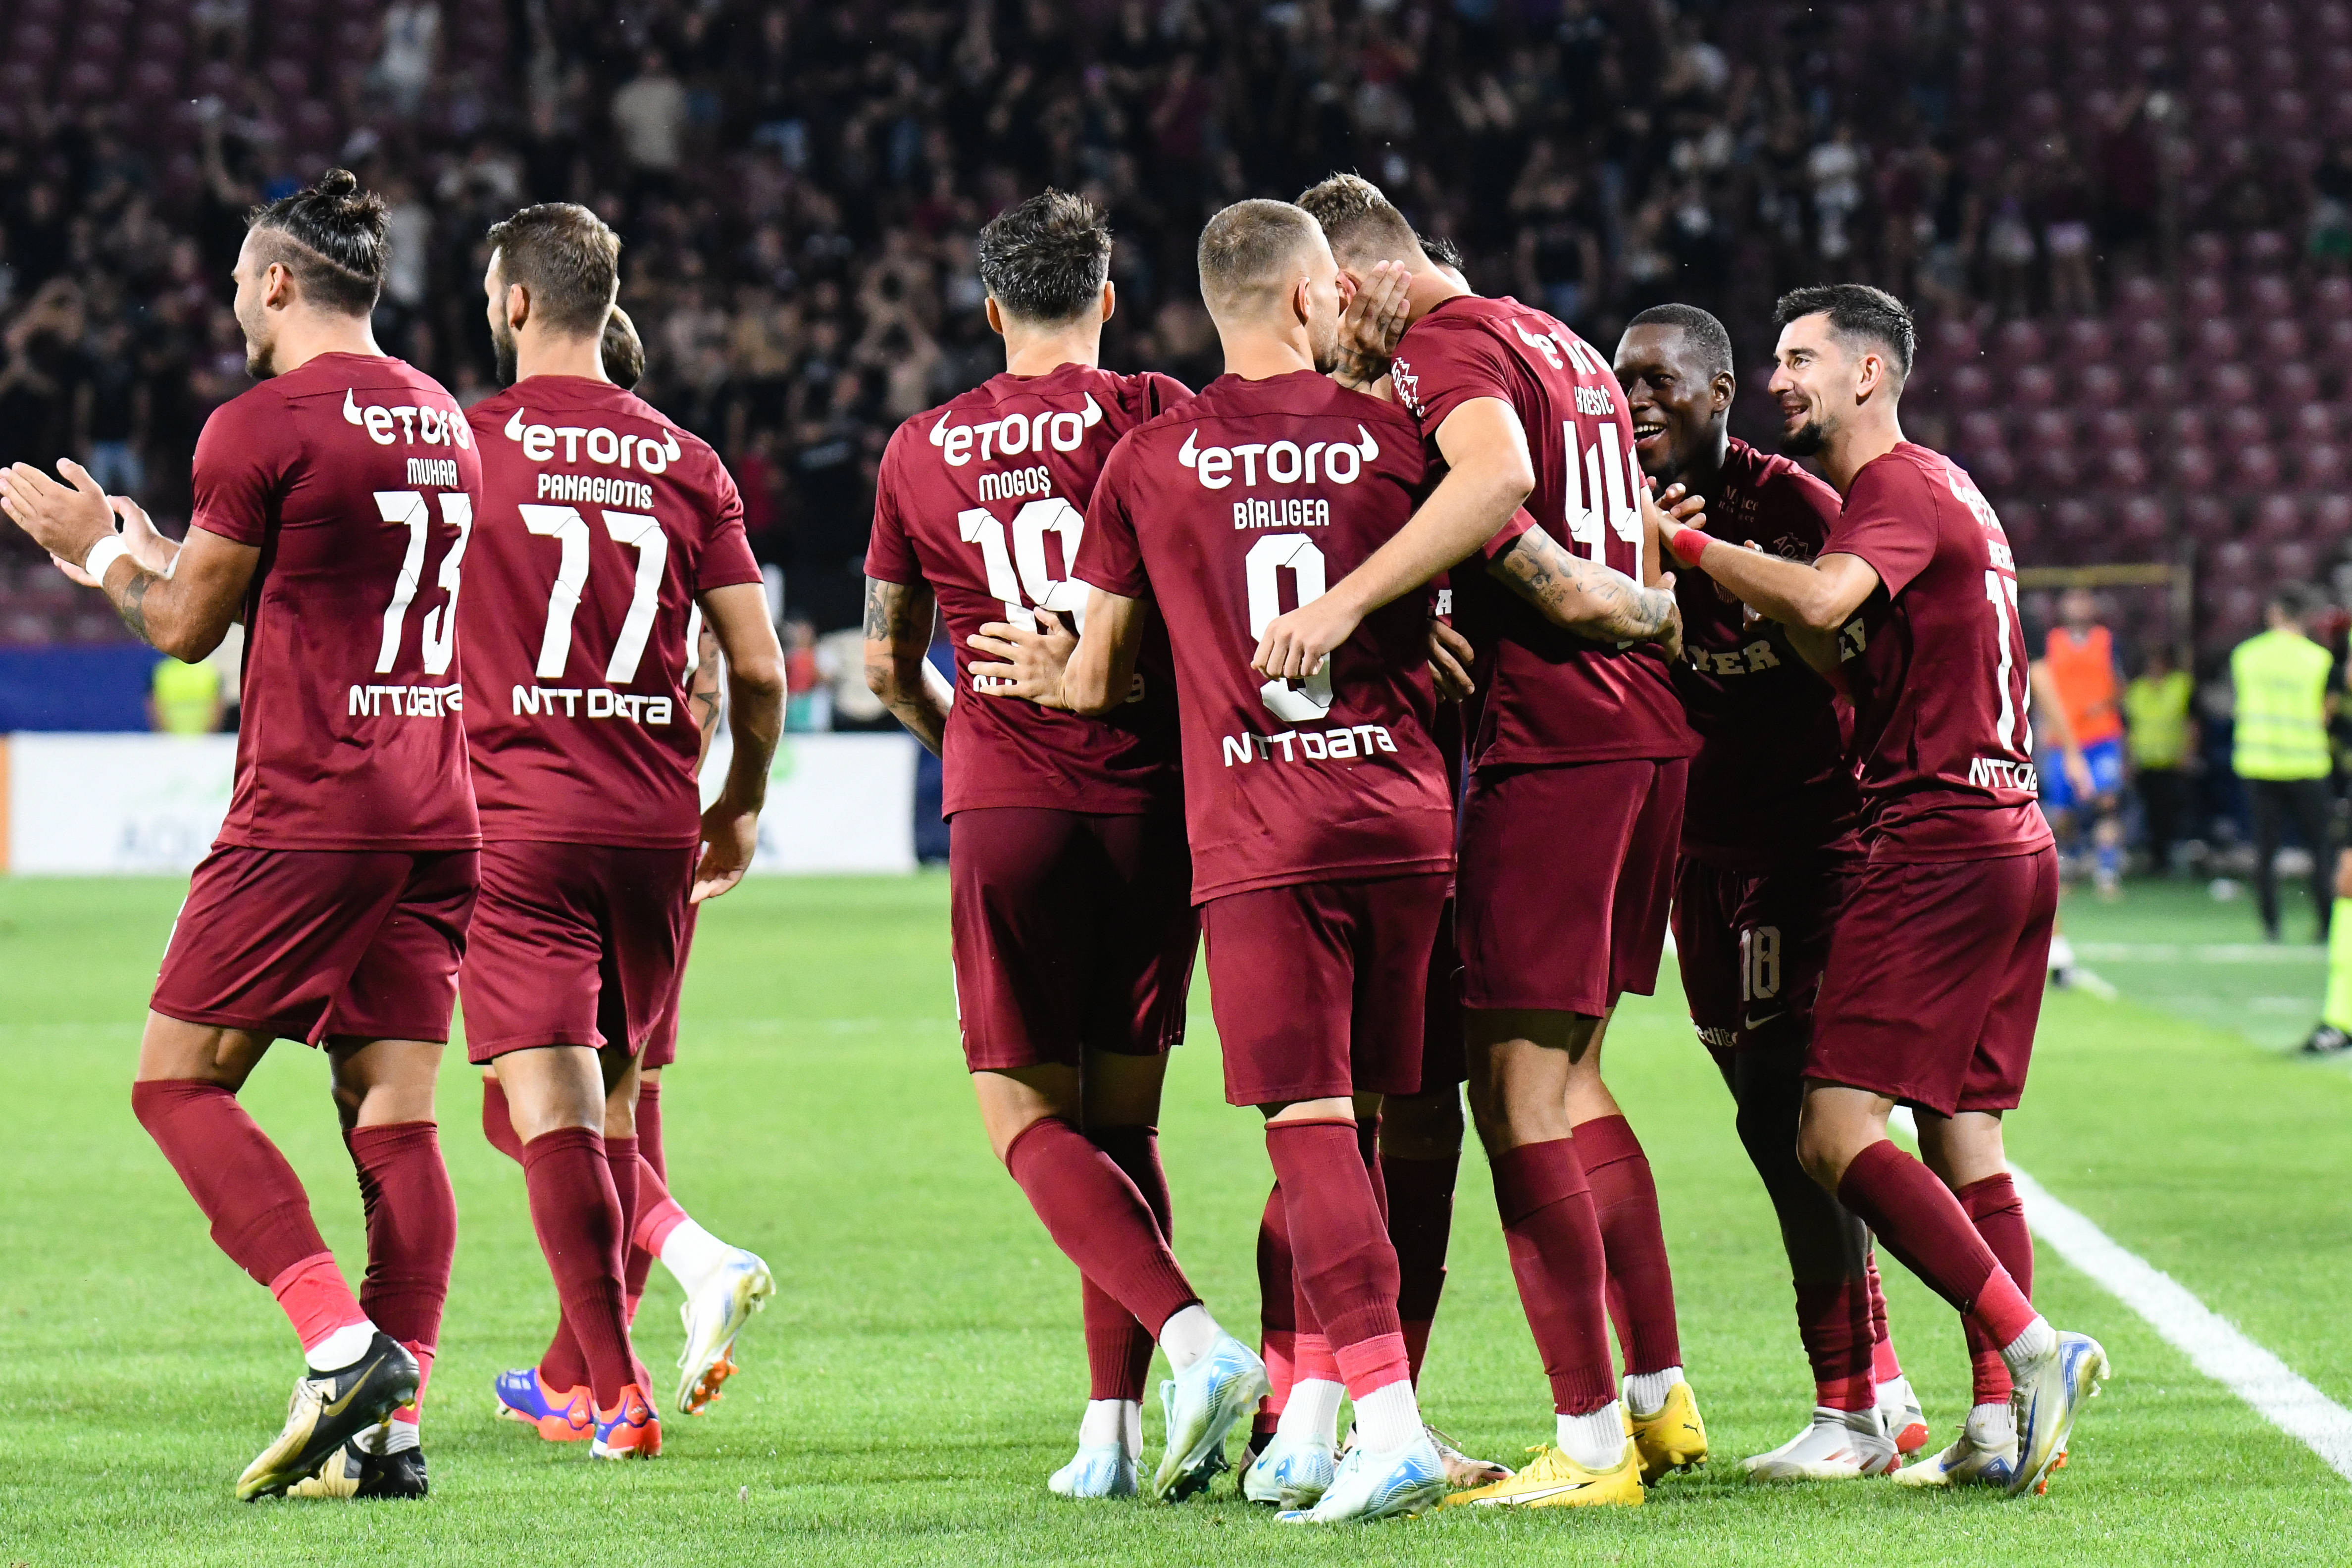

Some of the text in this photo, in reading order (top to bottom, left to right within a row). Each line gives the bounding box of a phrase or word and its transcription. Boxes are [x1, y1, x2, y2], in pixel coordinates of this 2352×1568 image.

[522, 423, 667, 474] eToro
[944, 411, 1083, 466] eToro
[1197, 440, 1361, 489] eToro
[407, 457, 458, 486] MUHAR
[538, 473, 654, 509] PANAGIOTIS
[1233, 497, 1330, 530] BÎRLIGEA
[1563, 420, 1645, 595] 44
[373, 490, 473, 675] 73
[518, 504, 668, 684] 77
[1741, 925, 1781, 1002] 18
